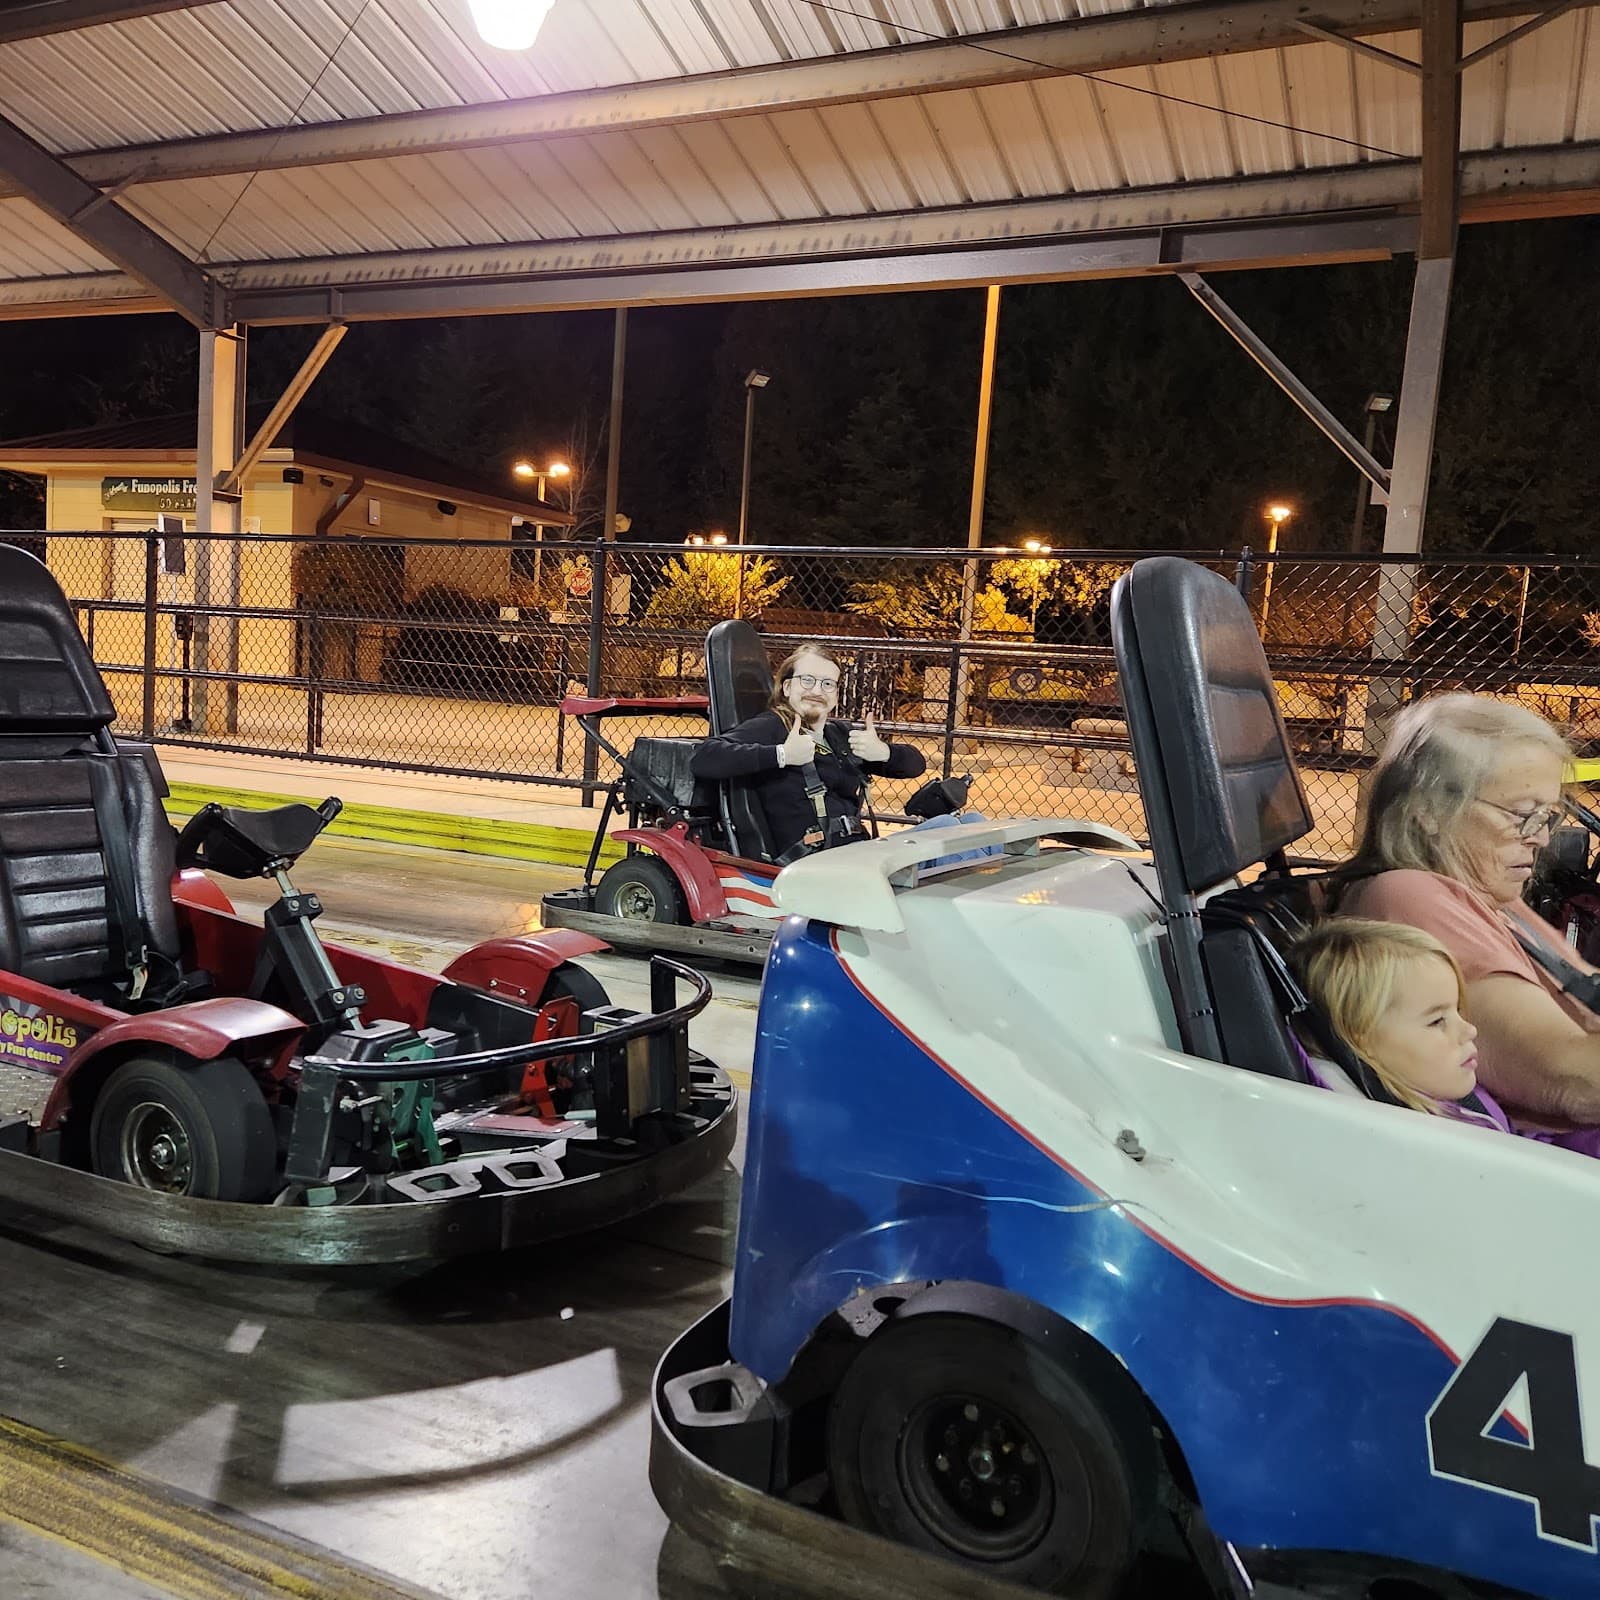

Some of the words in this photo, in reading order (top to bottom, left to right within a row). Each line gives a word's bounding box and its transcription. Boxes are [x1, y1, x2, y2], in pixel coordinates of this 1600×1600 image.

[131, 479, 181, 496] Funopolis
[0, 1009, 77, 1048] opolis
[7, 1042, 26, 1057] Fun
[27, 1047, 63, 1064] Center
[1426, 1315, 1600, 1553] 4
